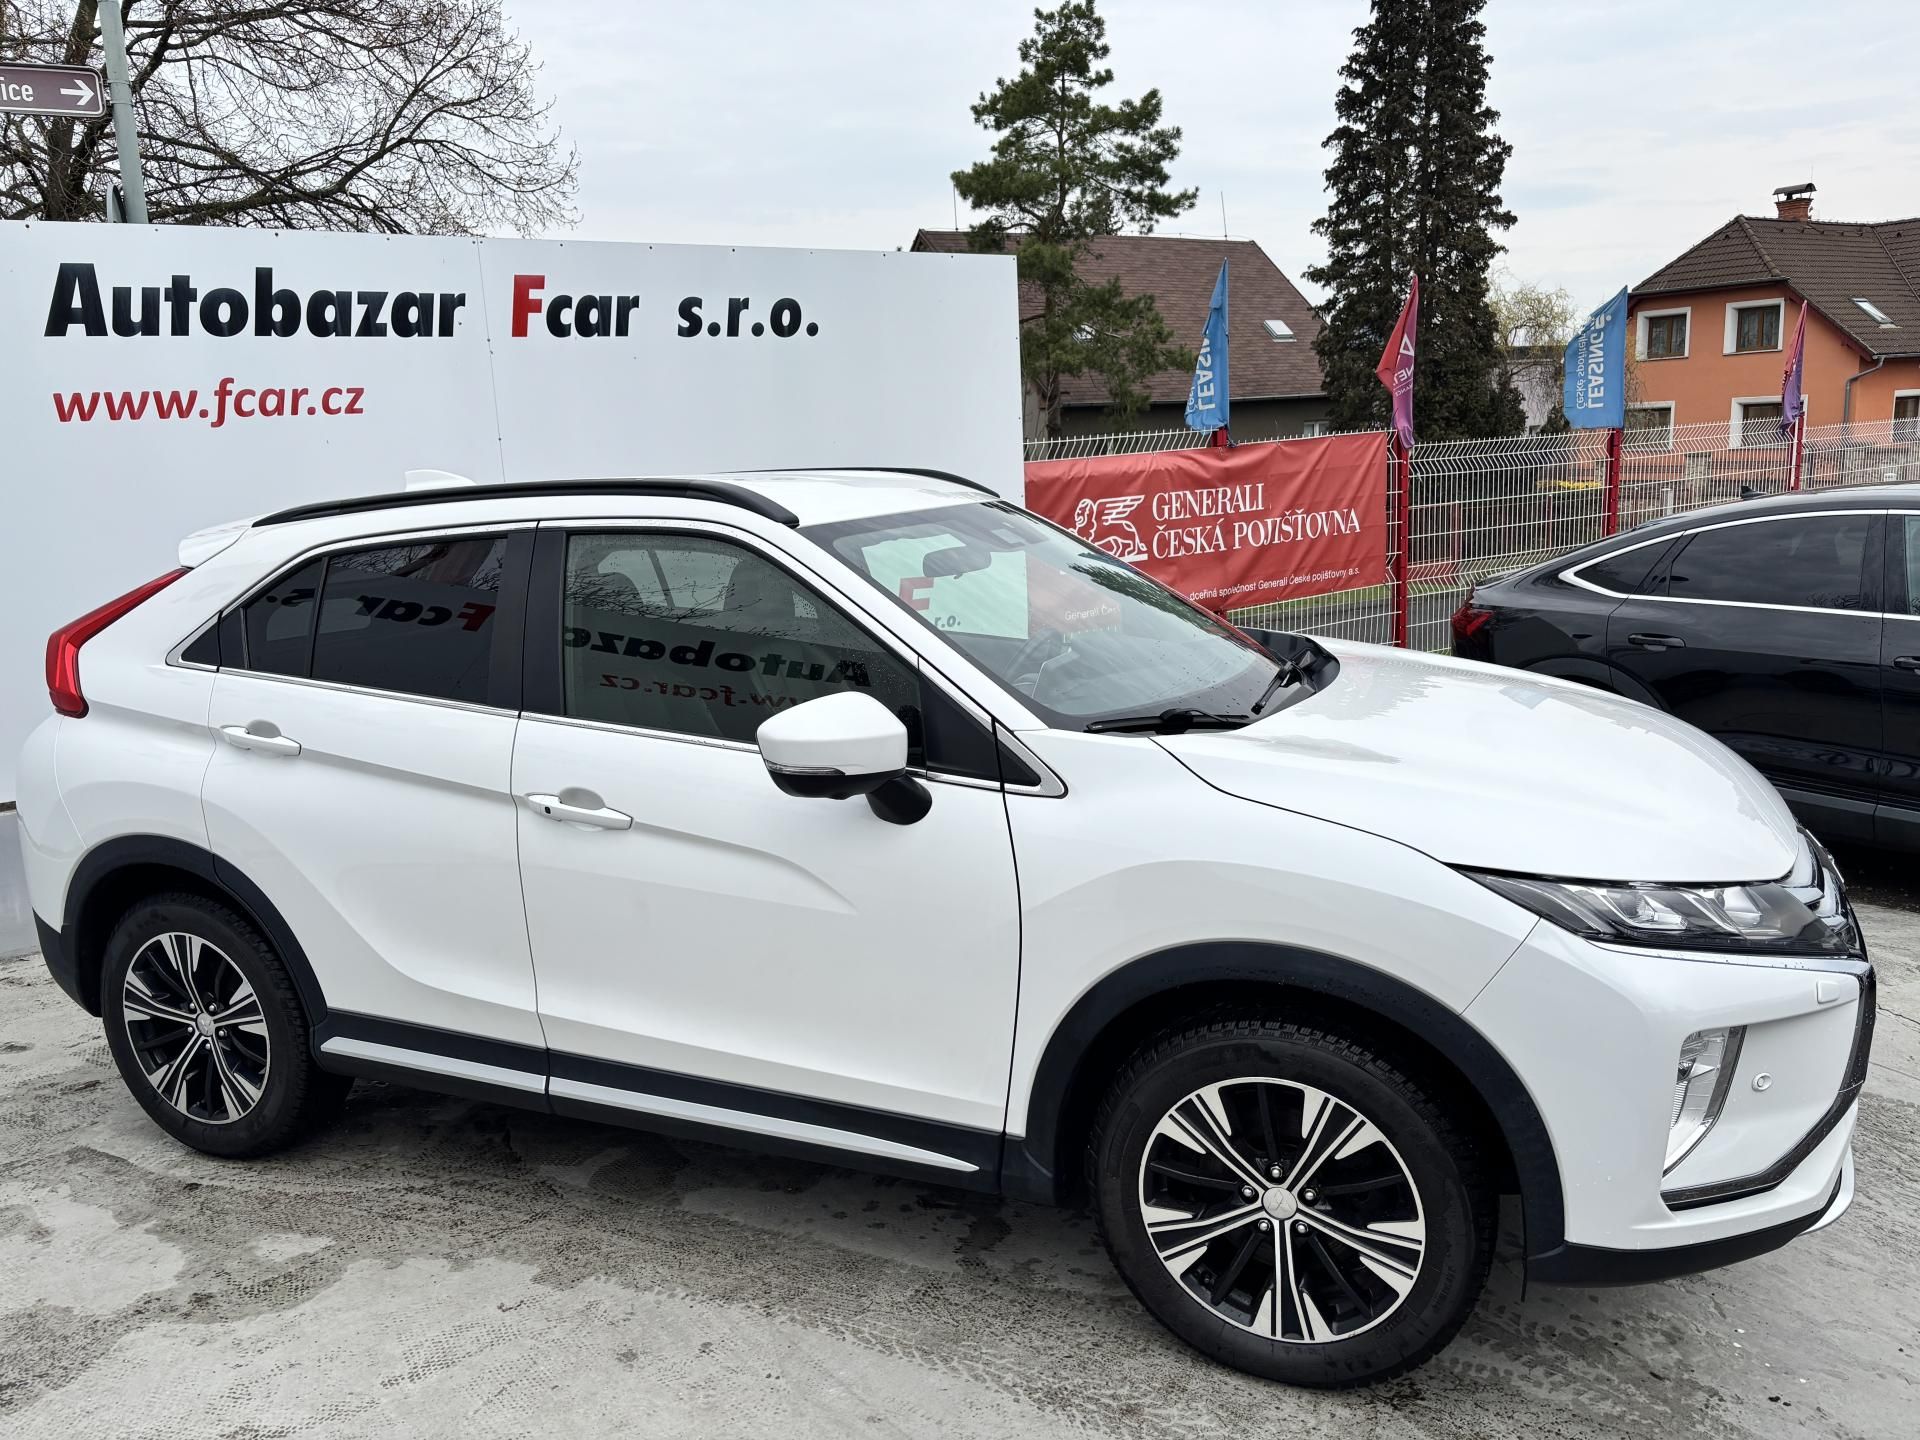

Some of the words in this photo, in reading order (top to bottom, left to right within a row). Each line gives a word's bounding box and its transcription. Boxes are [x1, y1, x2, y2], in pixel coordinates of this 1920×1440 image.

[44, 262, 466, 338] Autobazar
[512, 275, 640, 338] Fcar
[677, 296, 819, 338] s.r.o.
[52, 377, 366, 428] www.fcar.cz
[1152, 483, 1264, 520] GENERALI
[1153, 517, 1226, 559] ČESKÁ
[1233, 507, 1360, 550] POJIŠŤOVNA
[1258, 579, 1288, 591] Generali
